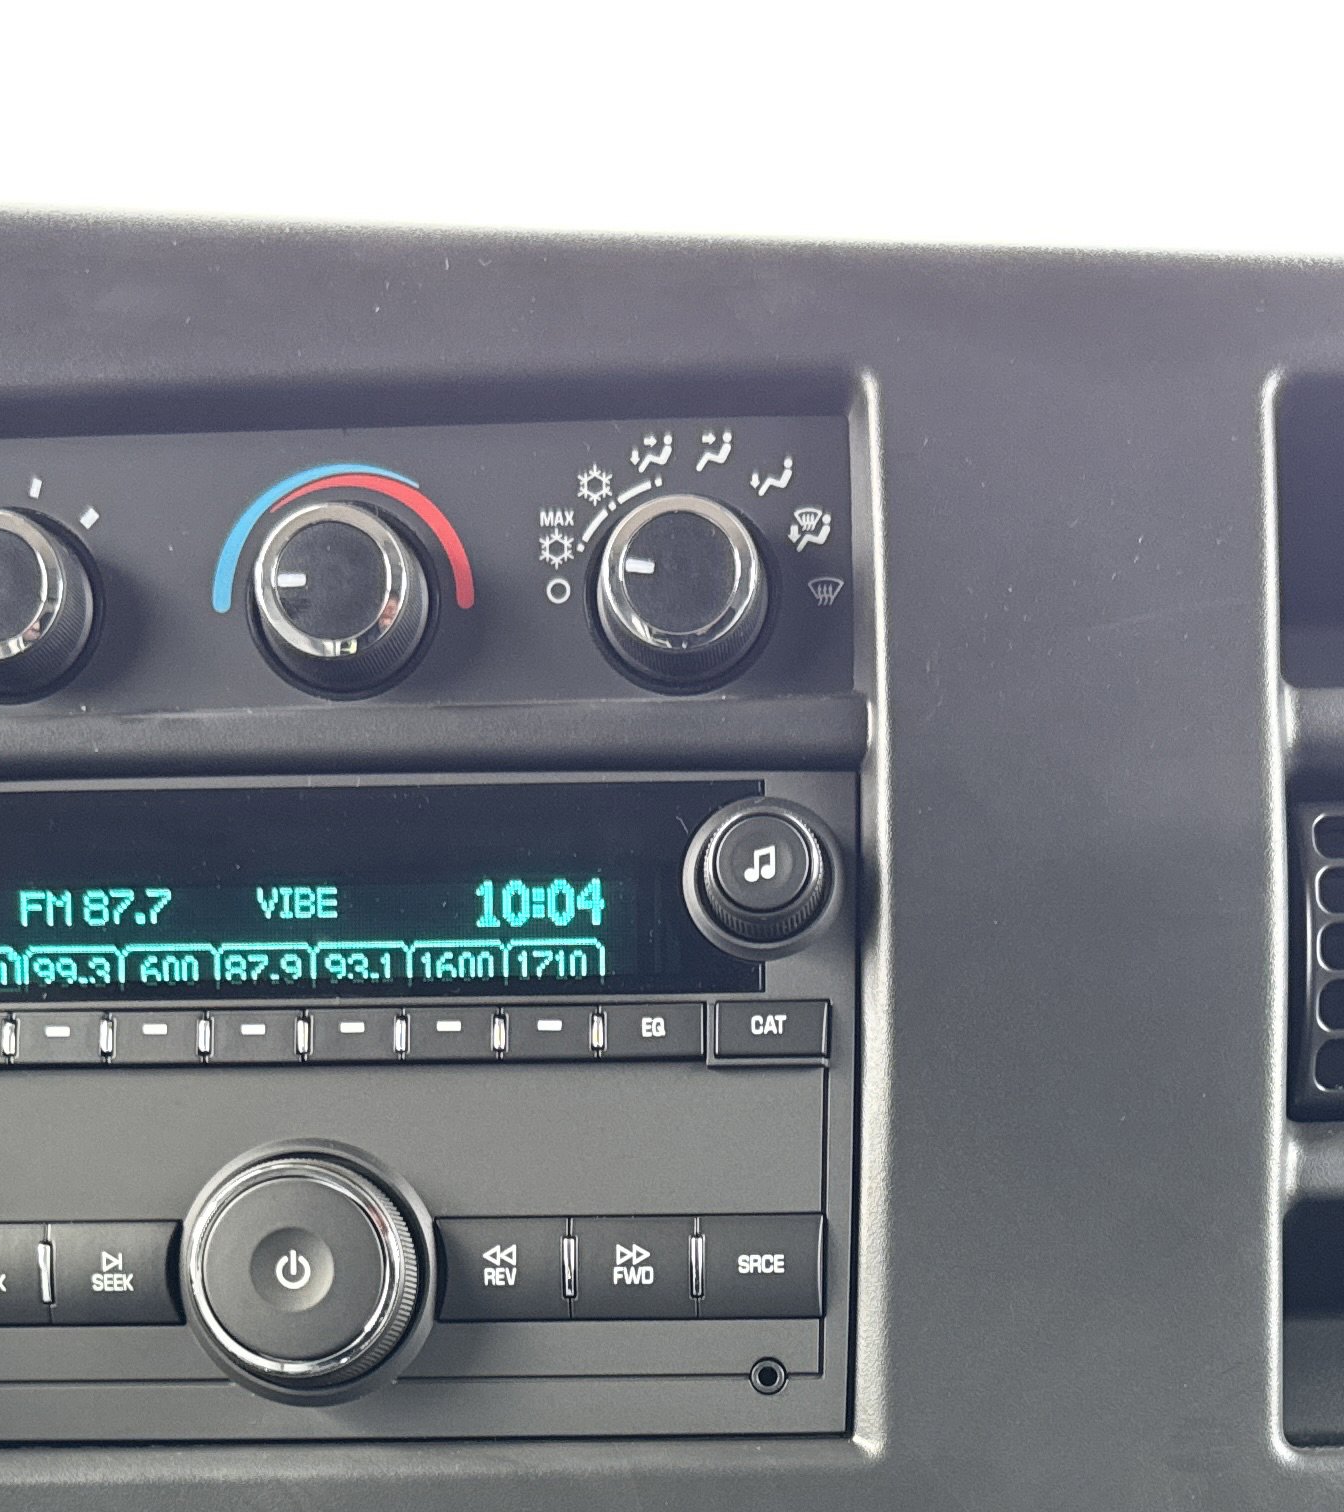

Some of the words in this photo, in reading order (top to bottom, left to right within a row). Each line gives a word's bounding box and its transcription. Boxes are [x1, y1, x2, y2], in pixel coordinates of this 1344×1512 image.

[539, 510, 575, 527] MAX
[19, 889, 72, 927] FM
[81, 888, 172, 926] 87.7
[256, 886, 339, 920] VIBE
[475, 878, 605, 928] 10:04
[641, 1017, 666, 1037] EQ
[751, 1014, 787, 1035] CAT
[737, 1254, 785, 1274] SRCE
[91, 1273, 134, 1292] SEEK
[484, 1267, 517, 1286] REV
[613, 1266, 654, 1285] FWD
